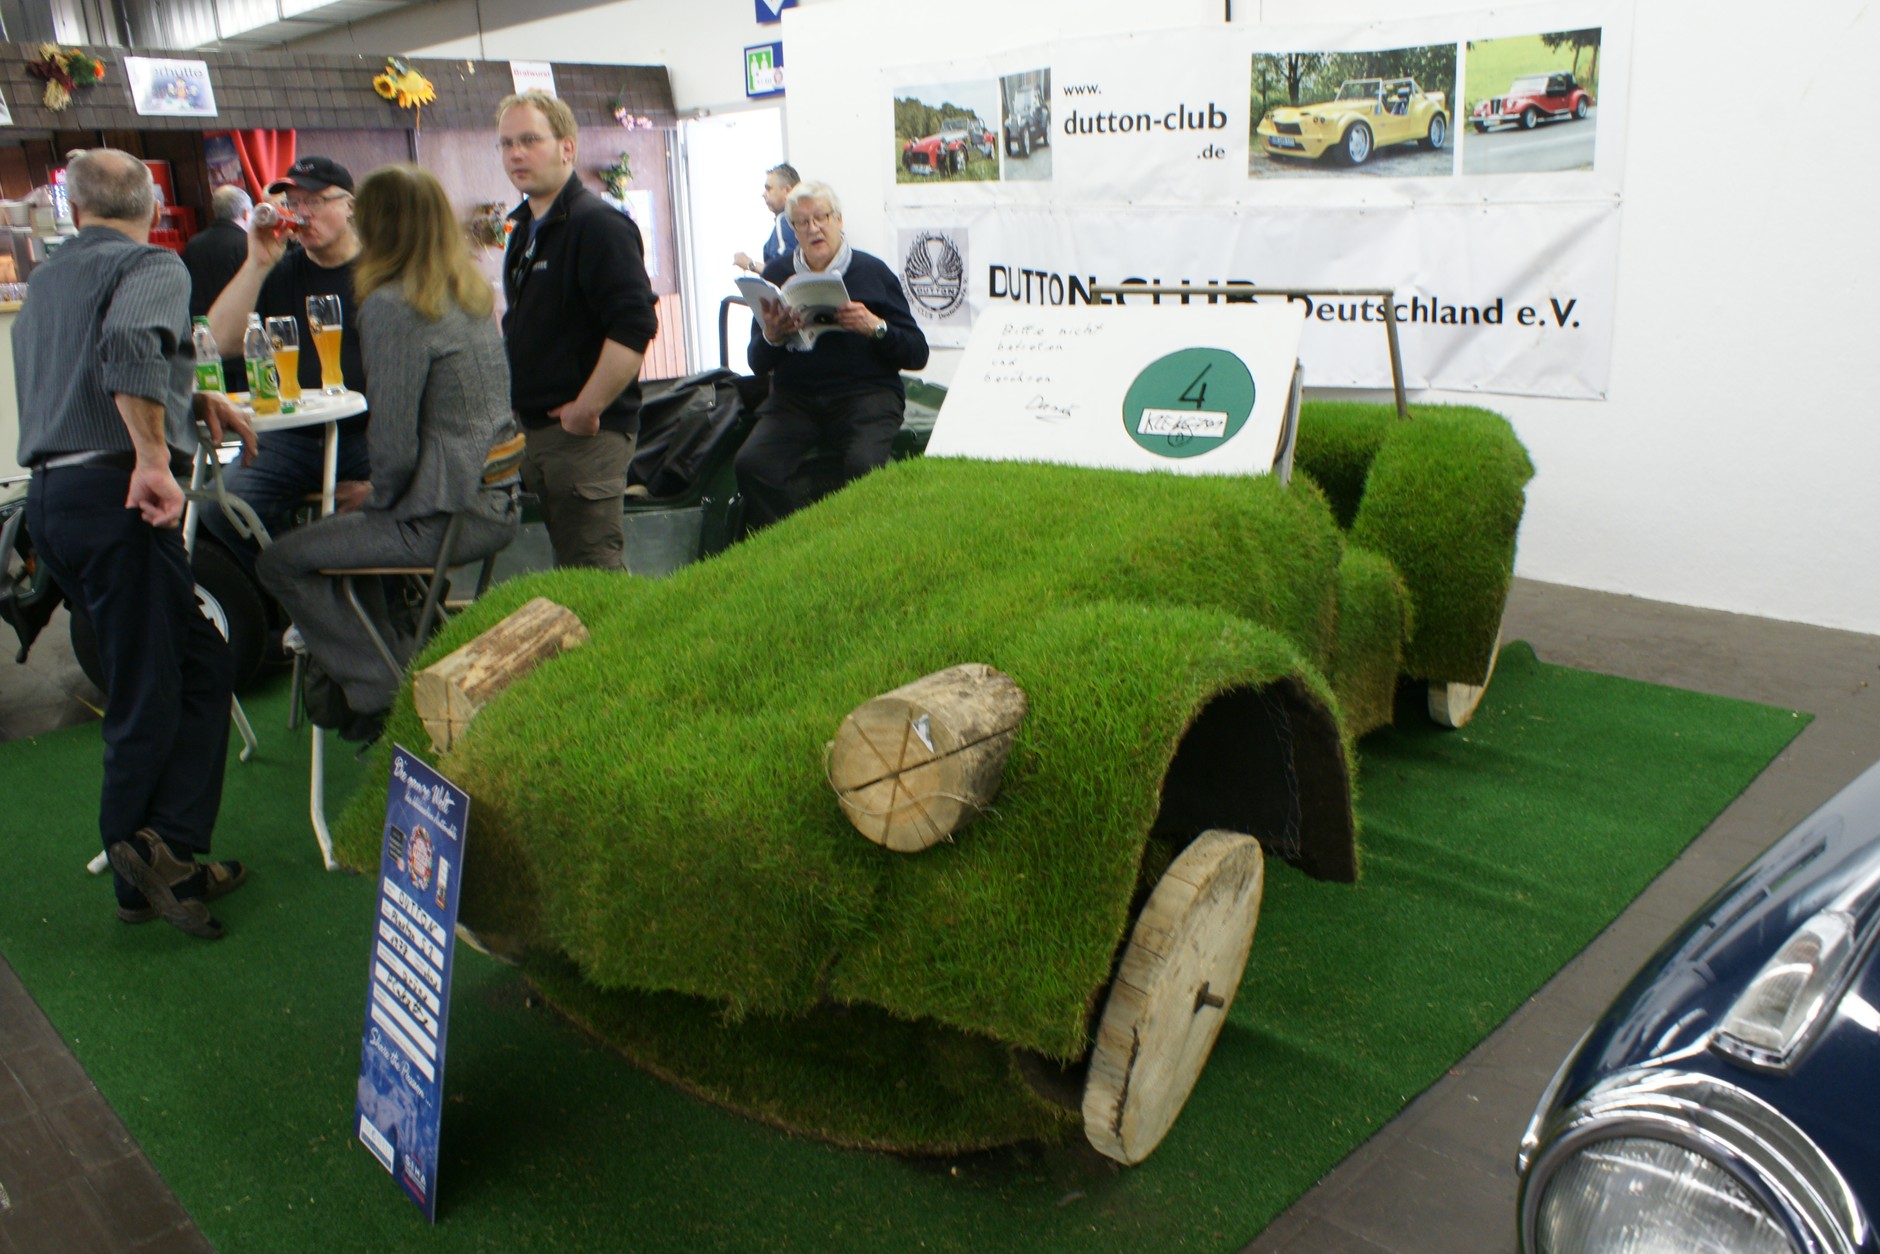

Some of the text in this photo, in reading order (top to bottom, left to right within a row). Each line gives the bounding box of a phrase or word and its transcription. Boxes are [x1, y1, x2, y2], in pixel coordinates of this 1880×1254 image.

[1063, 83, 1102, 97] www.
[1064, 102, 1228, 135] dutton-club
[1197, 144, 1226, 160] .de
[1178, 362, 1212, 411] 4
